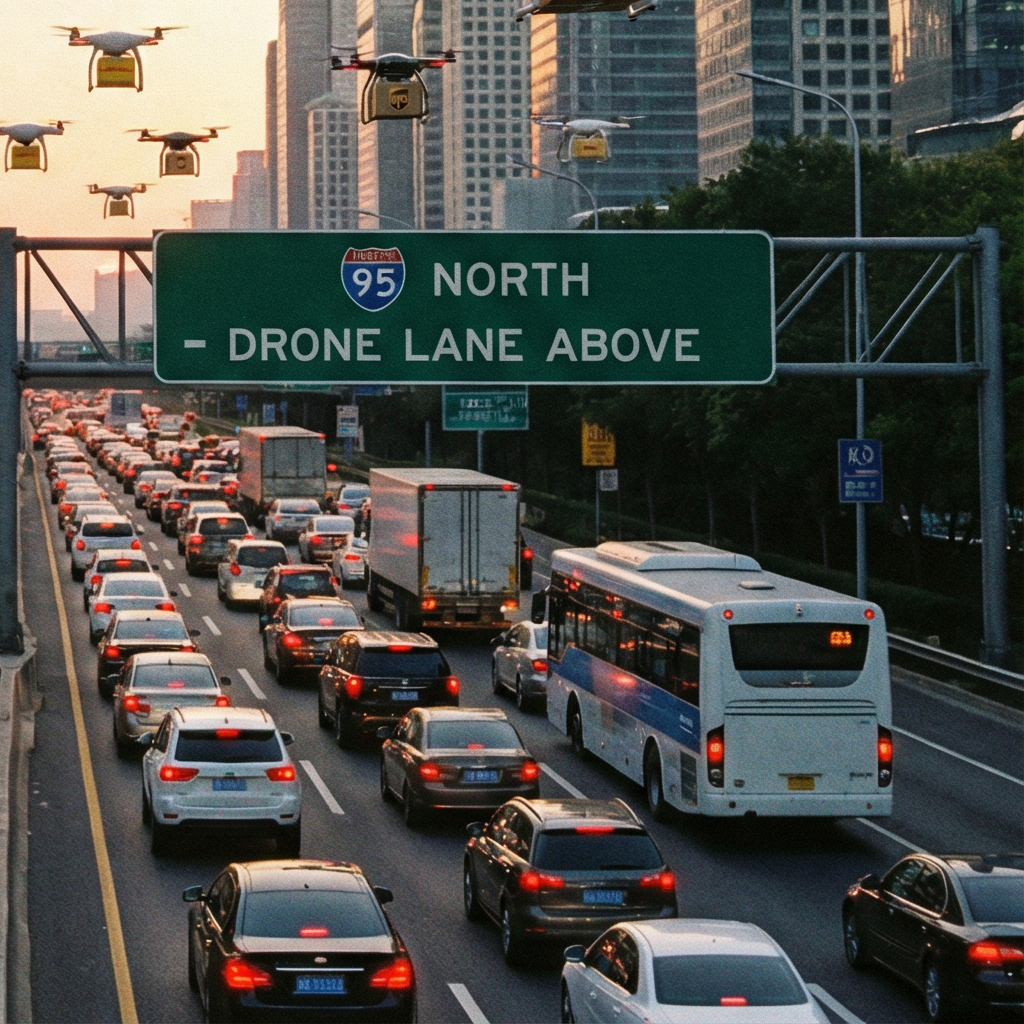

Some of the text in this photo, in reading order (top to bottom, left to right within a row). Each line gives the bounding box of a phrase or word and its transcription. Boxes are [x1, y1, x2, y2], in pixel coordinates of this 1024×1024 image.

[352, 261, 589, 297] 95 NORTH
[229, 327, 382, 362] DRONE
[405, 327, 523, 362] LANE
[545, 327, 701, 362] ABOVE
